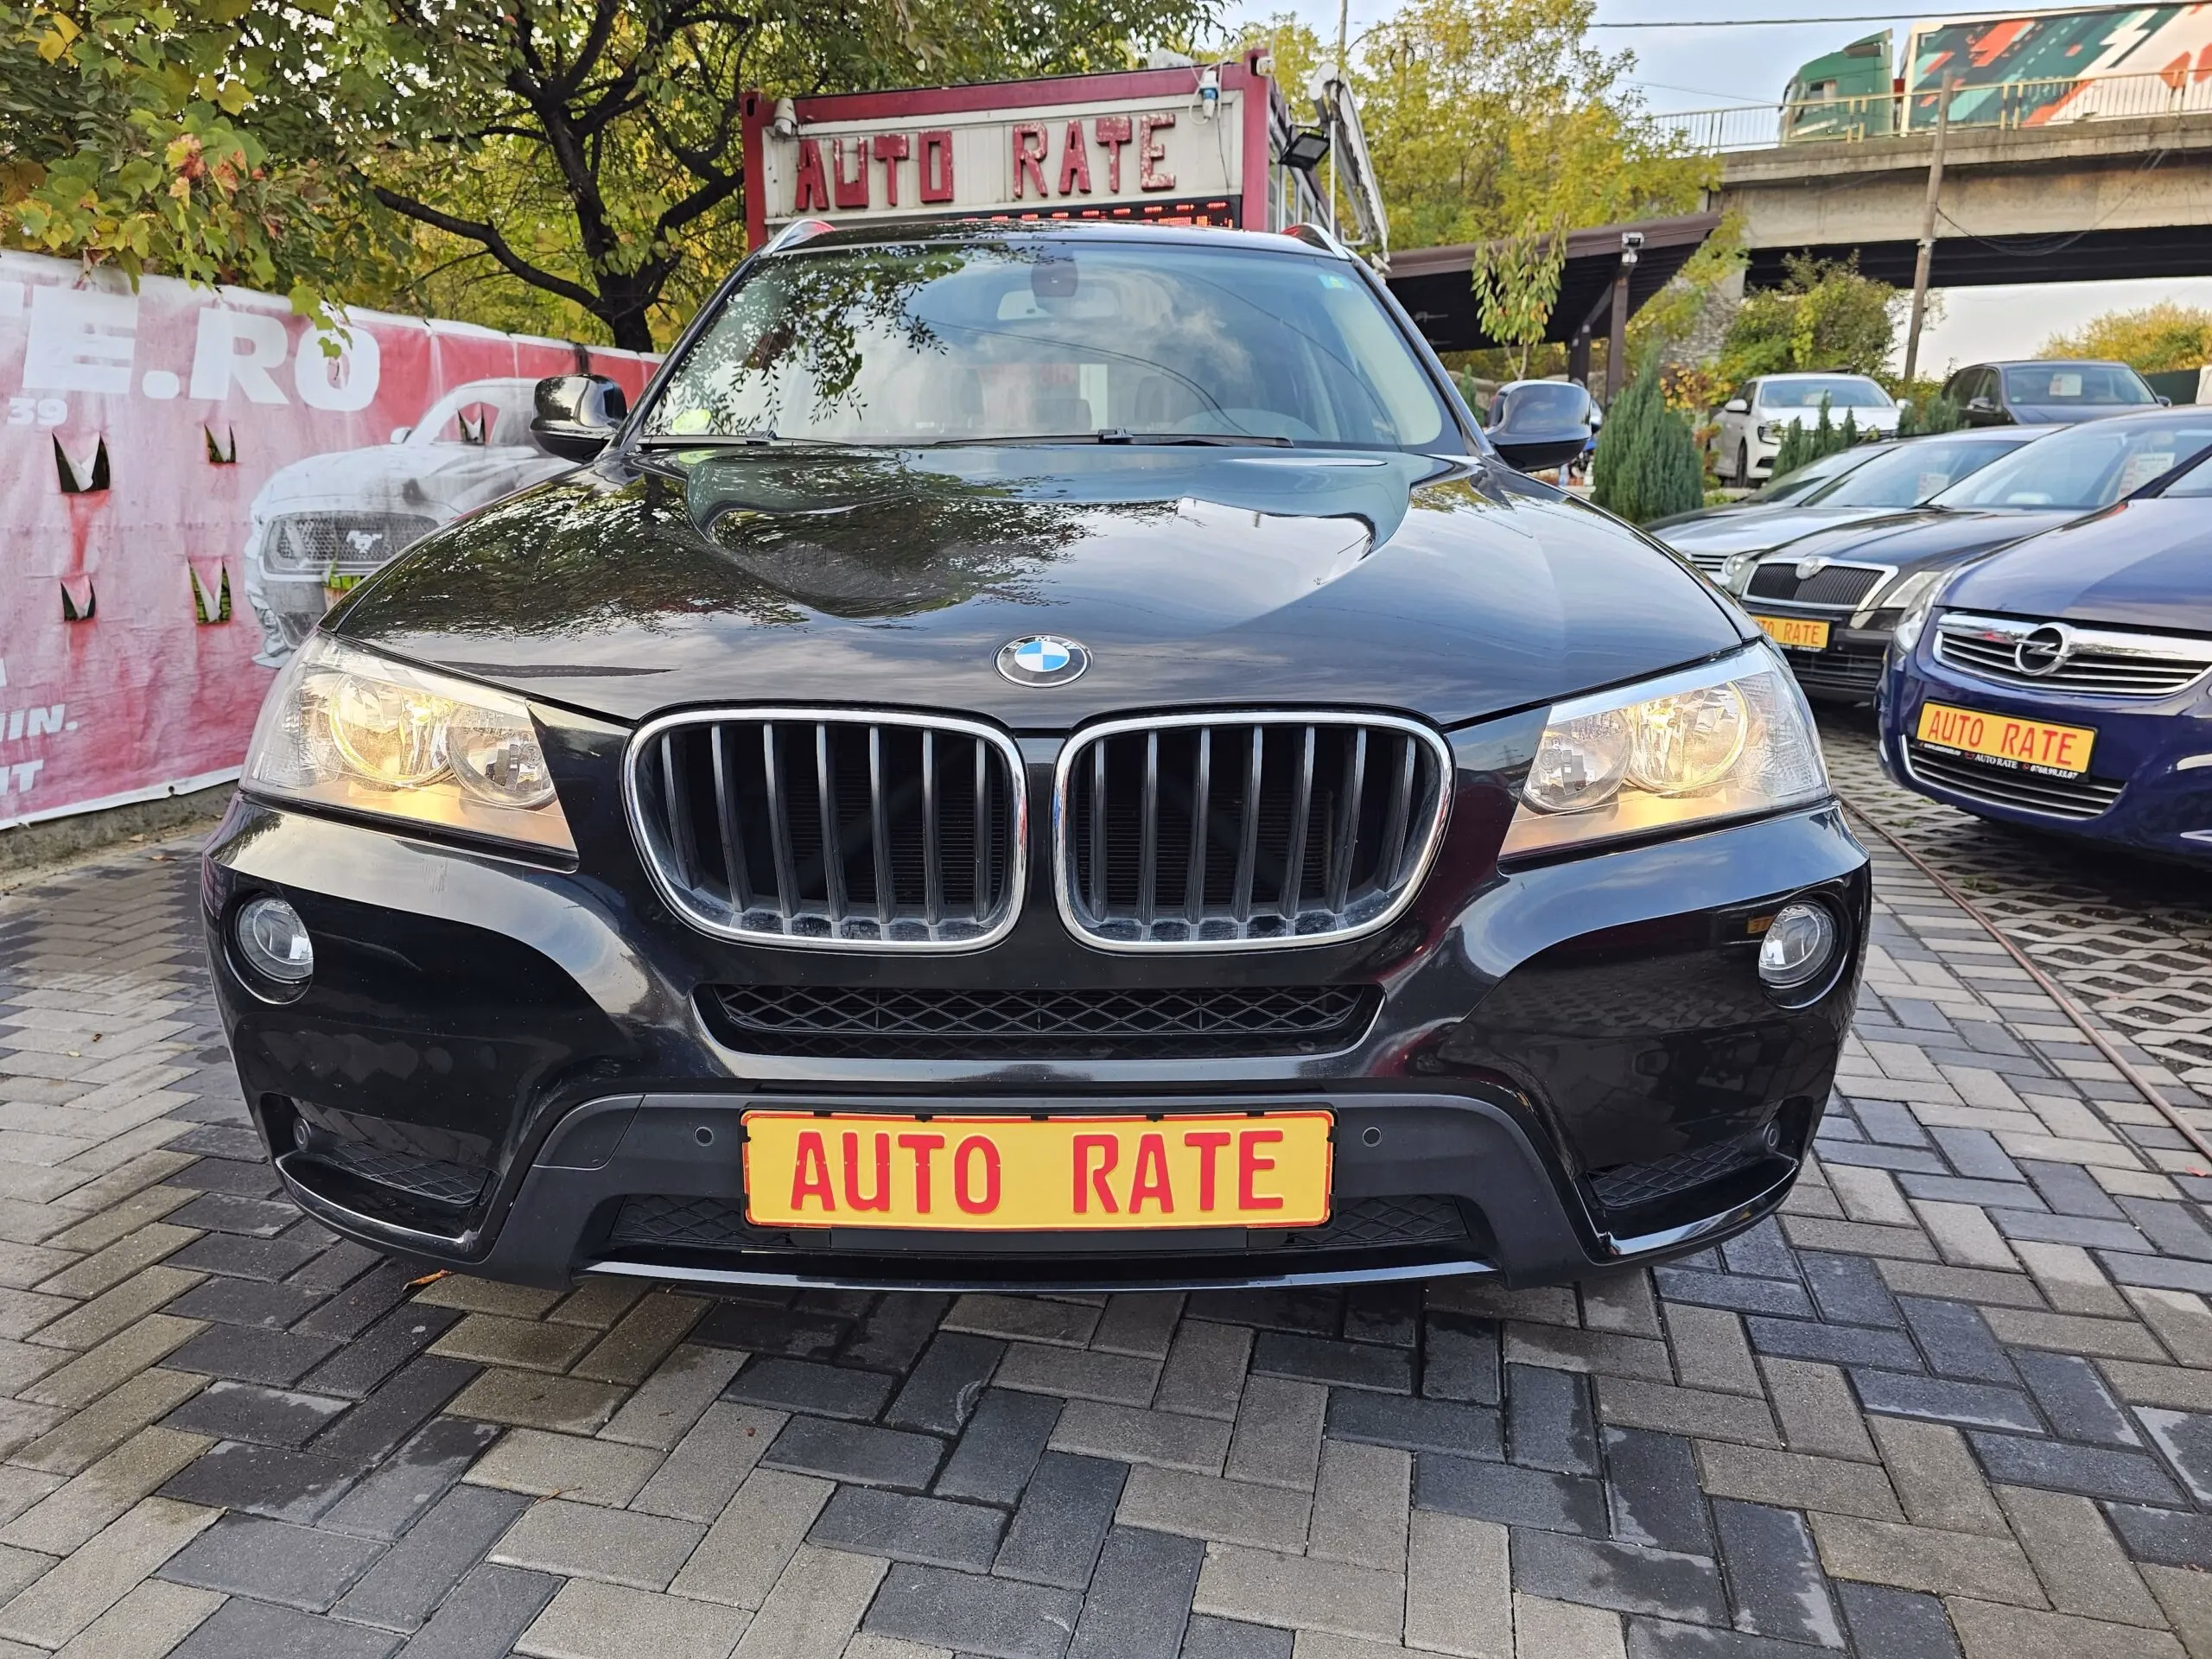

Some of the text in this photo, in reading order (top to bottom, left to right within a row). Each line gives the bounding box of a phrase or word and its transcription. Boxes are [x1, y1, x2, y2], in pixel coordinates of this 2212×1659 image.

[795, 113, 1176, 212] AUTO RATE
[0, 281, 380, 411] E.RO
[7, 397, 68, 426] 39
[1006, 633, 1079, 650] BMW
[1783, 622, 1821, 645] RATE
[0, 703, 79, 743] IN.
[1928, 709, 2077, 766] AUTO RATE
[1974, 753, 2018, 769] AUTO RATE
[790, 1129, 1285, 1215] AUTO RATE
